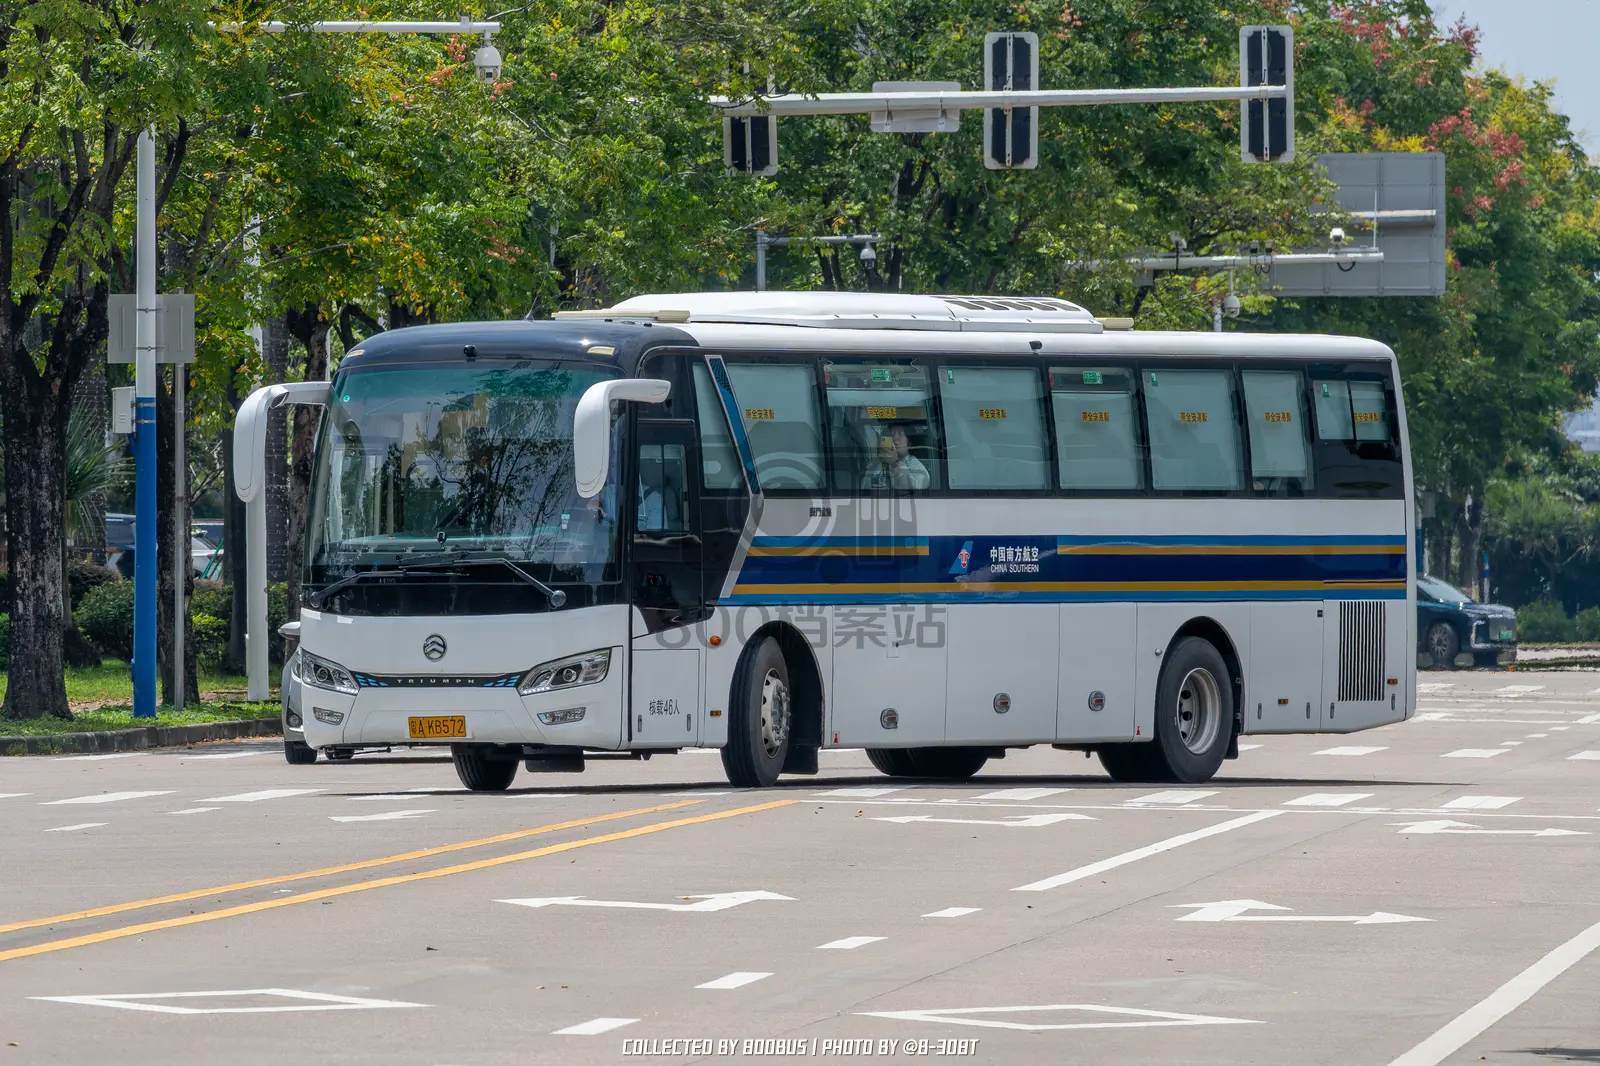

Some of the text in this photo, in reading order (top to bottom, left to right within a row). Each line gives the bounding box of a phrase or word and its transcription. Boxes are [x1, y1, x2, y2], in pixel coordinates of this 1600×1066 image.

[990, 546, 1039, 562] 中国南方航空
[990, 564, 1039, 573] CHINA SOUTHERN
[649, 699, 680, 716] 核载46人
